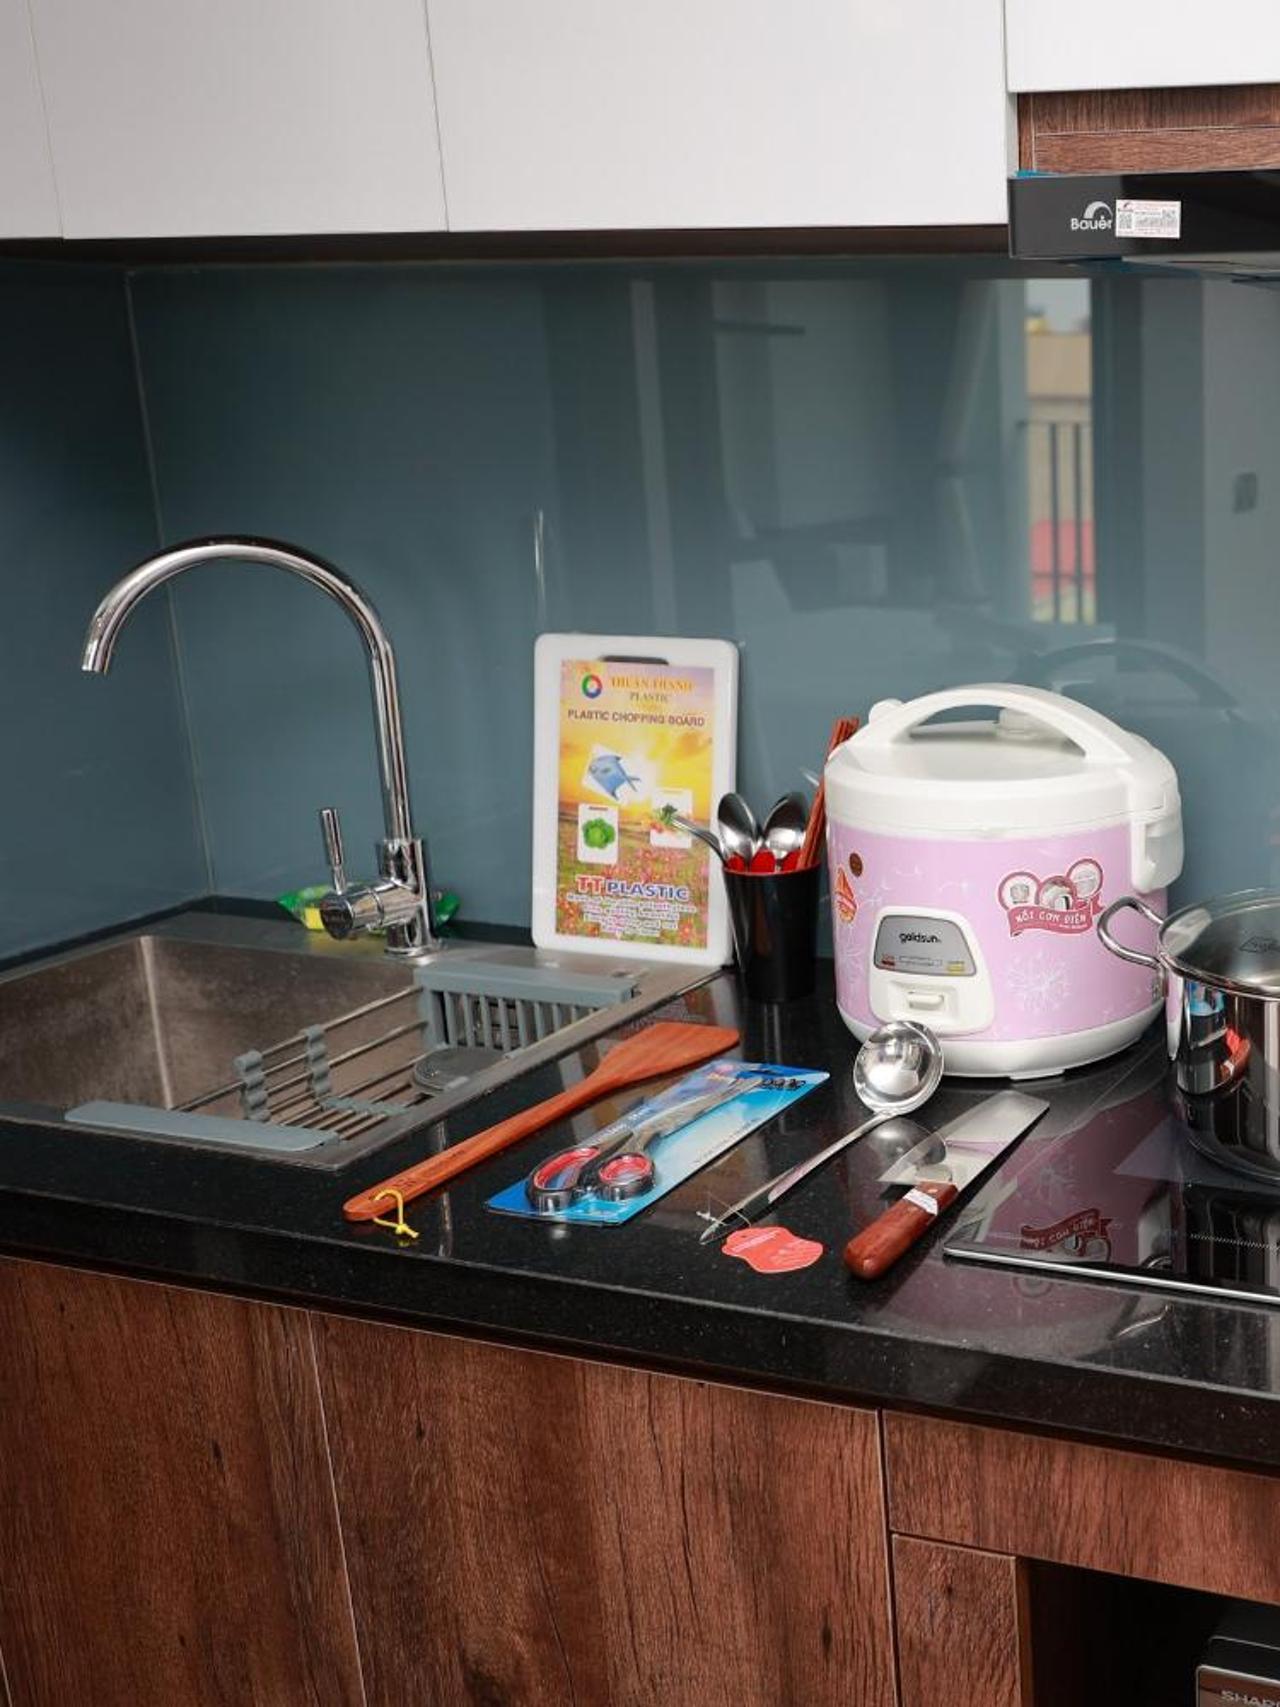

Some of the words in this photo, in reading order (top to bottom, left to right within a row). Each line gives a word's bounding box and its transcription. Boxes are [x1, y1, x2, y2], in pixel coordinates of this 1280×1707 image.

[567, 709, 609, 721] PLASTIC
[611, 712, 665, 724] CHOPPING
[667, 716, 705, 727] BOARD
[576, 875, 606, 893] TT
[607, 879, 689, 902] PLASTIC
[899, 933, 938, 943] goldsun
